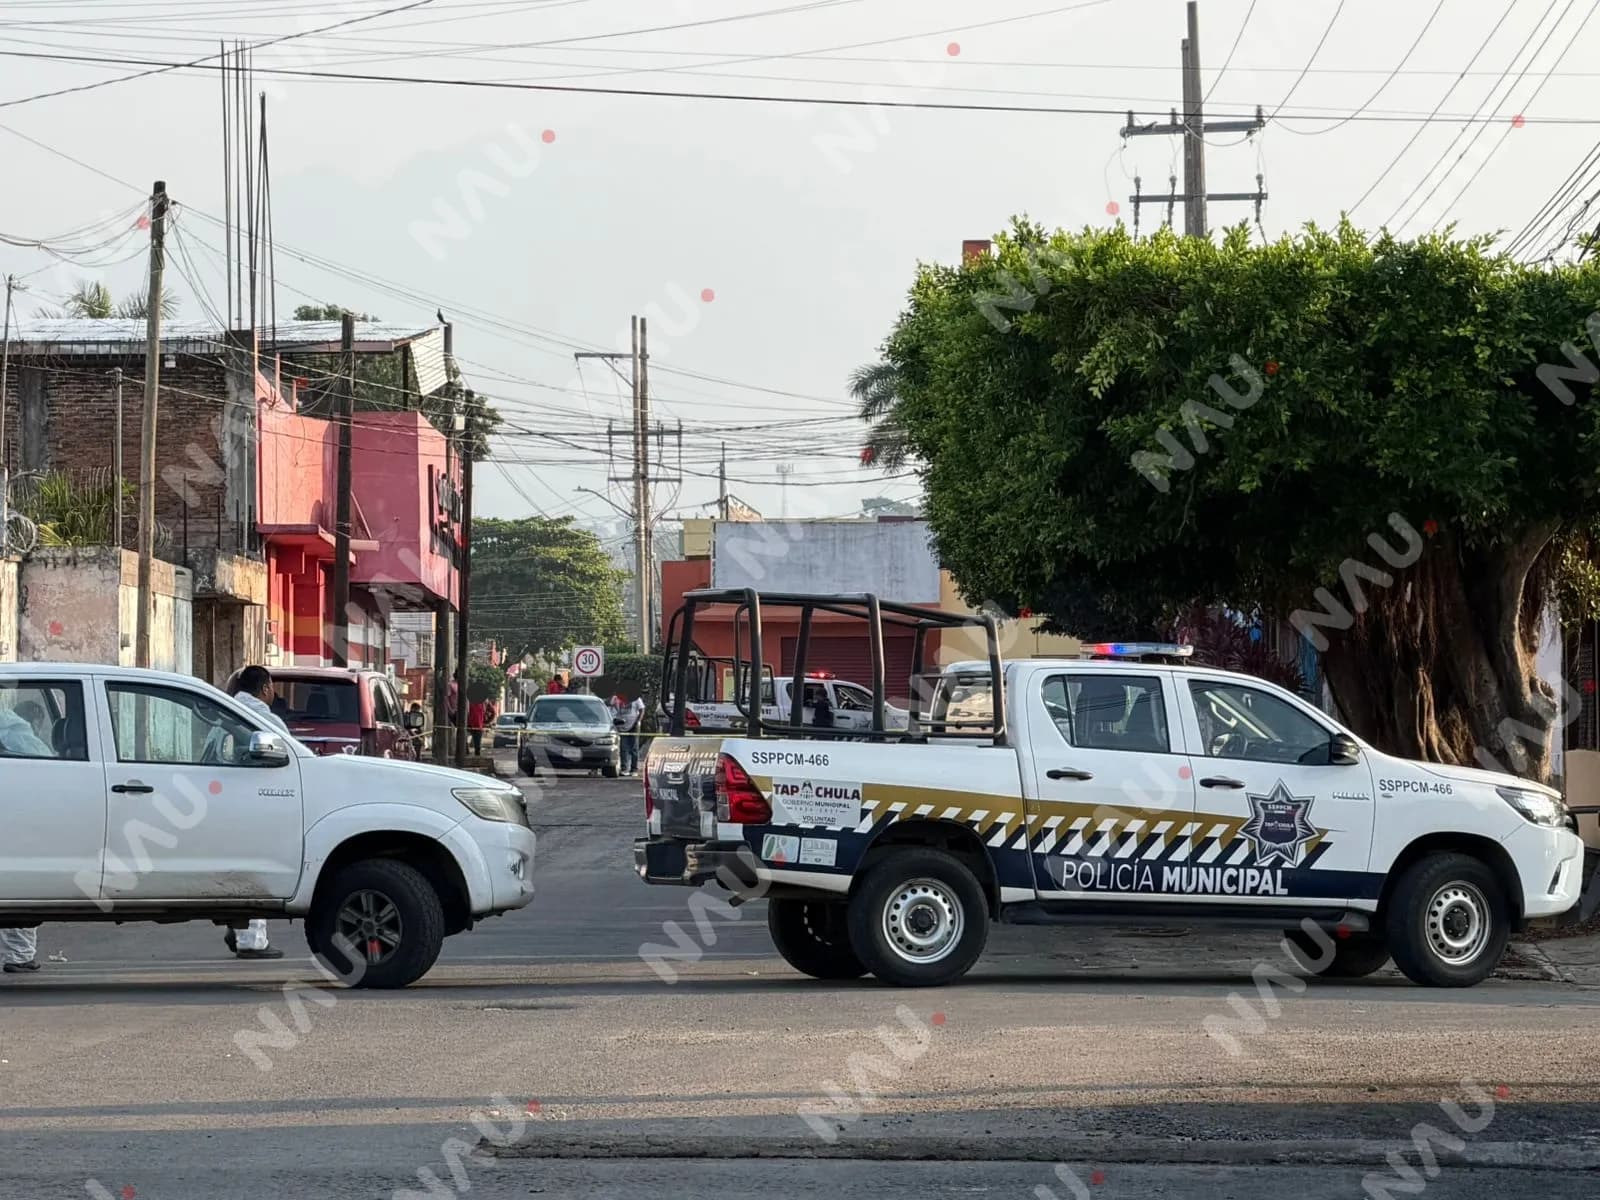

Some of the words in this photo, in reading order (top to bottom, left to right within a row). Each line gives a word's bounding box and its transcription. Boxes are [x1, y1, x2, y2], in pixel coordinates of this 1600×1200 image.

[582, 653, 595, 666] 30
[751, 751, 830, 767] SSPPCM-466
[1379, 779, 1453, 795] SSPPCM-466
[1062, 858, 1154, 892] POLICÍA
[1161, 865, 1289, 896] MUNICIPAL
